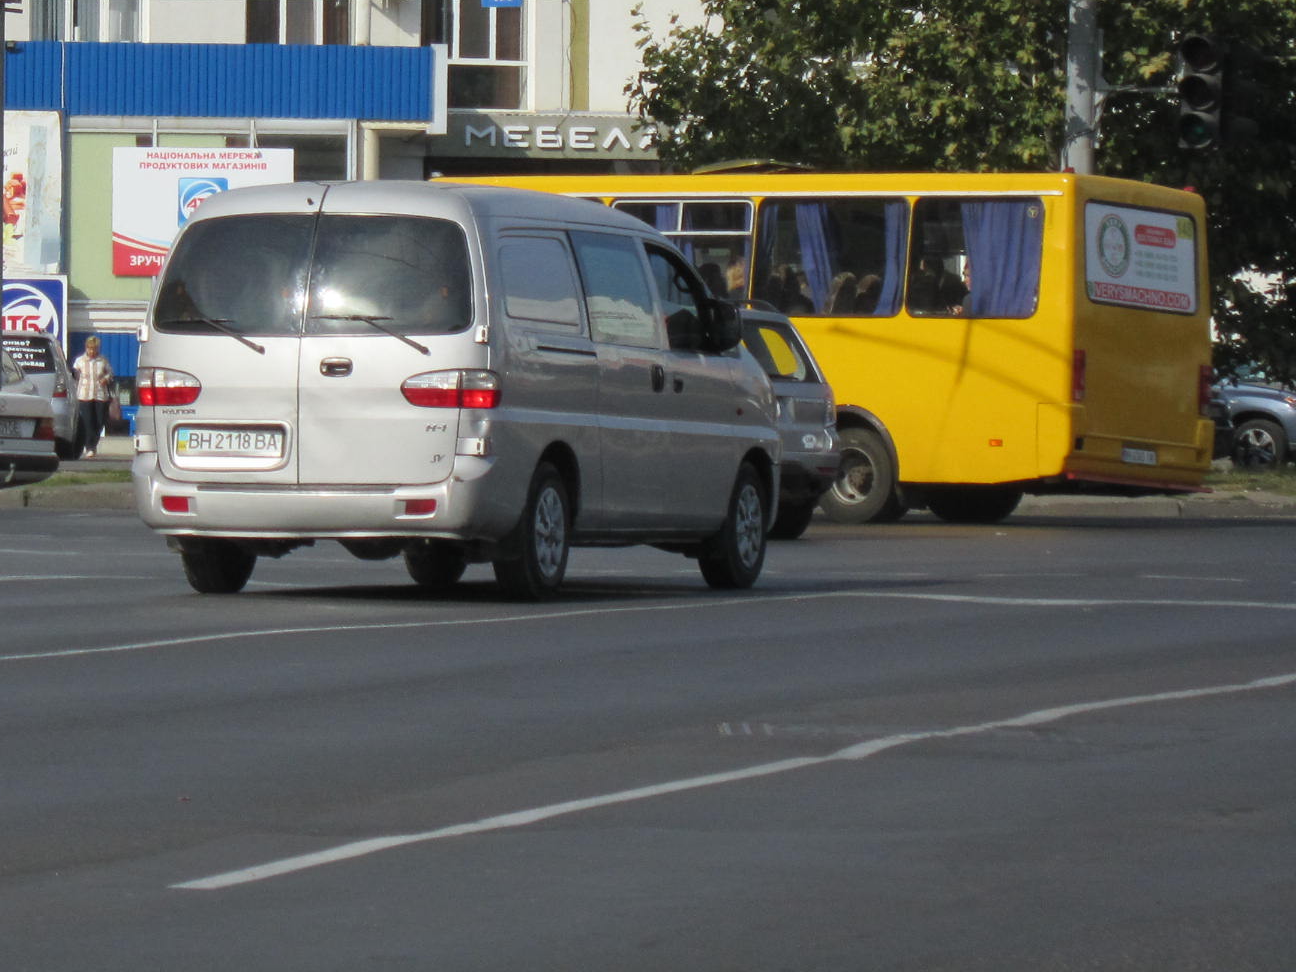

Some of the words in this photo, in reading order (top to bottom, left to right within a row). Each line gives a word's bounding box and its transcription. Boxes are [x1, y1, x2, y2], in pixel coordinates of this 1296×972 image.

[146, 152, 216, 160] НАЦІОНАЛЬНА
[139, 162, 210, 170] ПРОДУКТОВИХ
[212, 162, 267, 170] МАГАЗИНІВ
[189, 432, 212, 449] BH
[215, 433, 252, 449] 2118
[254, 434, 278, 450] BA
